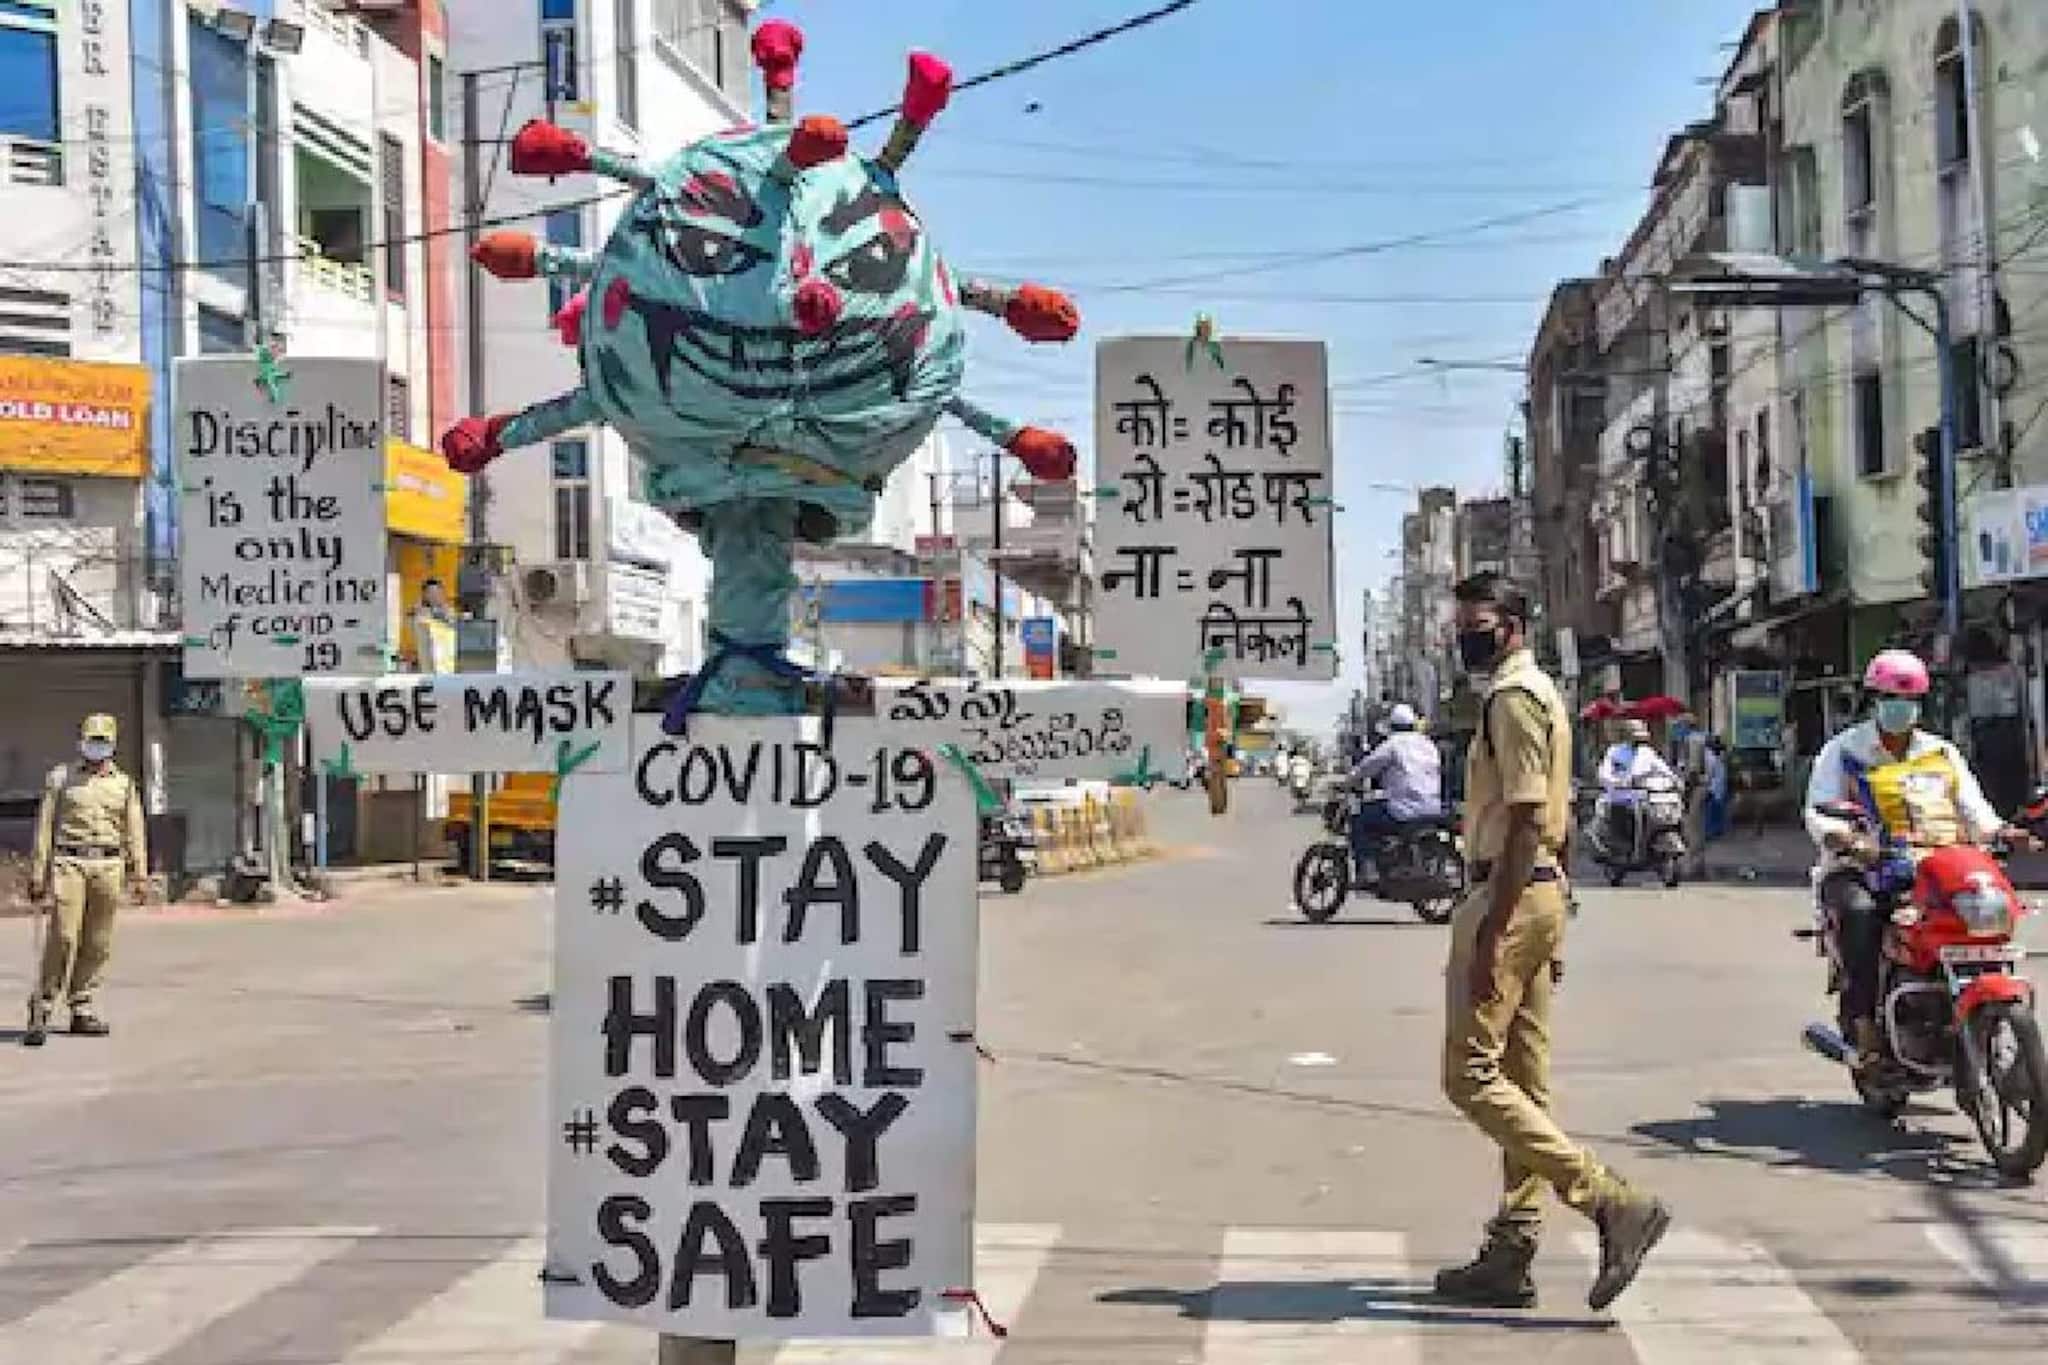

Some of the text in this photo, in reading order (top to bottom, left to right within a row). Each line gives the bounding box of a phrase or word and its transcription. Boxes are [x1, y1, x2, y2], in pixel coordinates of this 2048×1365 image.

[60, 403, 130, 428] LOAN
[1207, 377, 1298, 456] कोई
[204, 476, 243, 527] is
[266, 475, 341, 521] the
[235, 527, 342, 570] only
[201, 569, 376, 604] Medicine
[303, 643, 341, 671] 19
[338, 680, 614, 744] USE MASK
[636, 742, 935, 814] COVID-19
[601, 976, 926, 1088] HOME
[591, 1194, 920, 1319] SAFE
